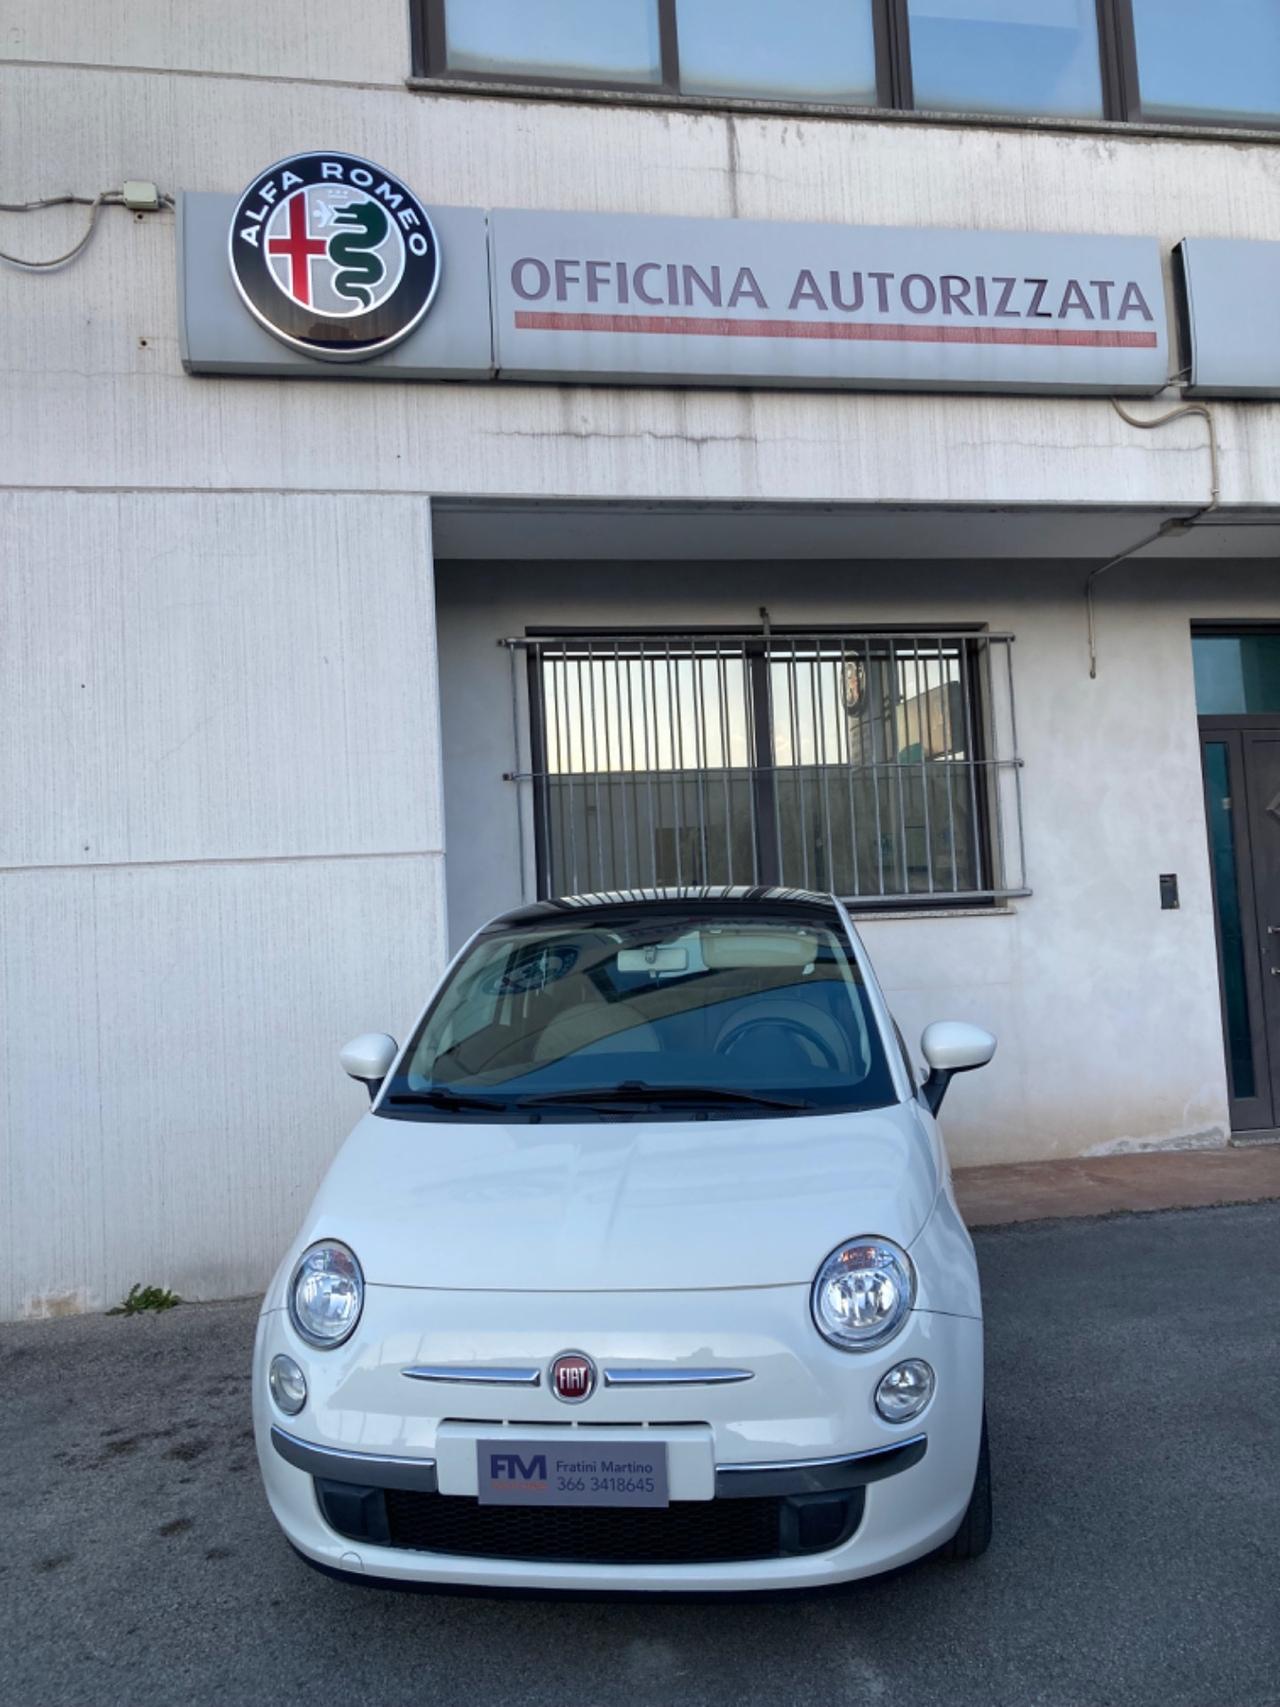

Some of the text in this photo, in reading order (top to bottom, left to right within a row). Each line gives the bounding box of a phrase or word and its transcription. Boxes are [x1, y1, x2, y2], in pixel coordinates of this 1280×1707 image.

[240, 162, 428, 258] ALFA ROMEO
[511, 257, 1155, 321] OFFICINA AUTORIZZATA
[559, 1366, 587, 1390] FIAT
[490, 1454, 548, 1480] FM
[556, 1460, 653, 1474] Fratini Martino
[557, 1476, 585, 1491] 366
[591, 1477, 655, 1493] 3418645
